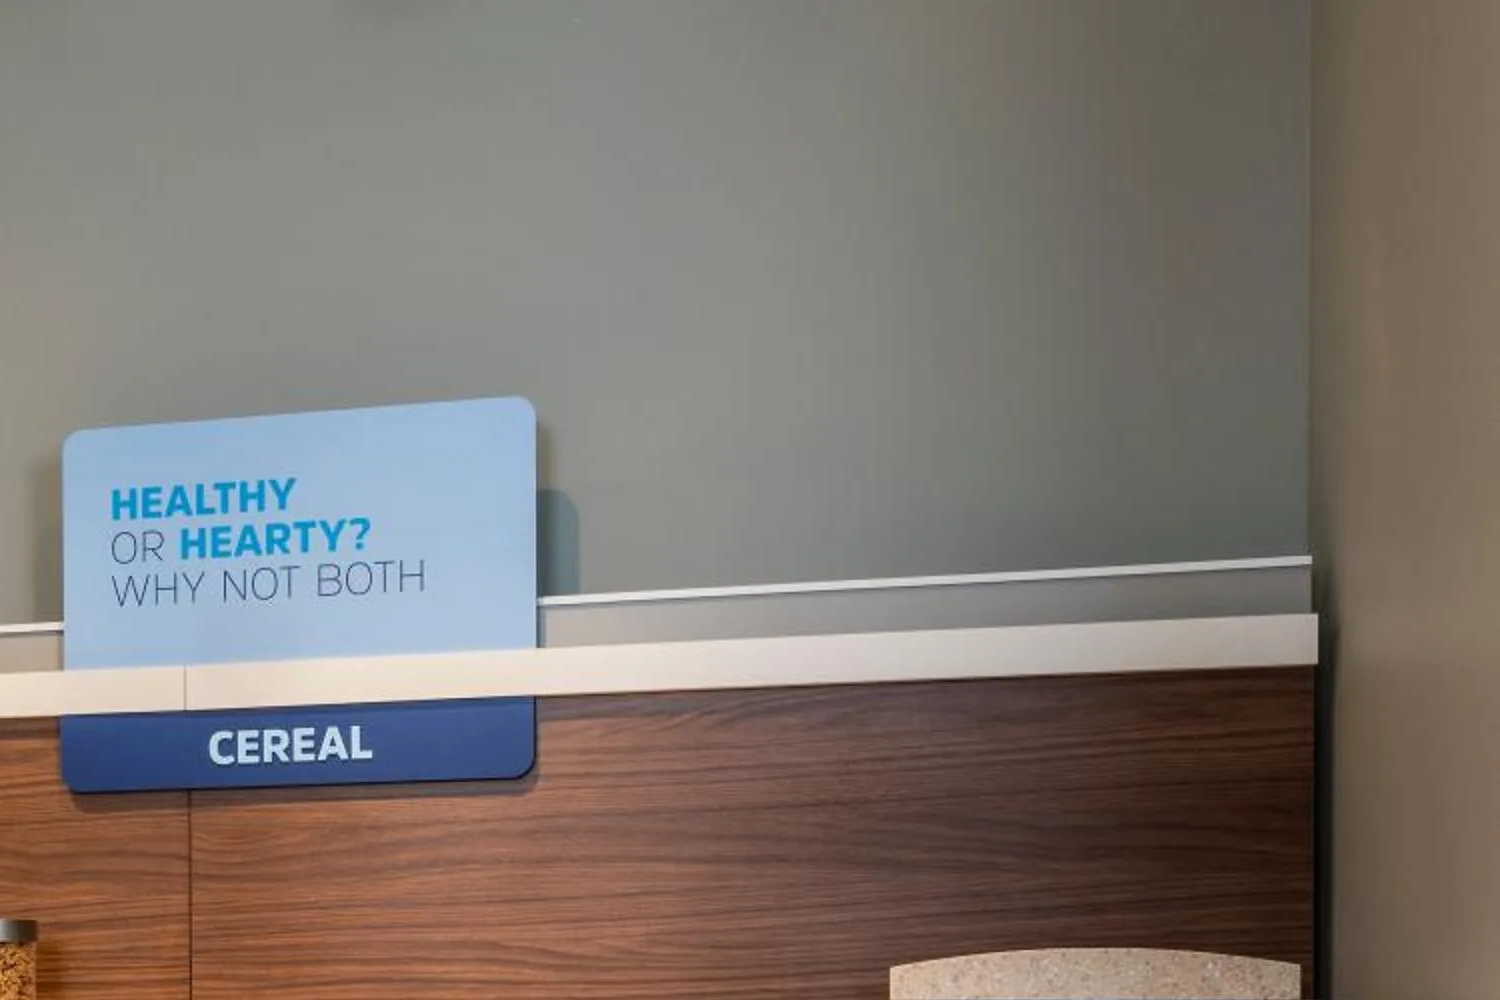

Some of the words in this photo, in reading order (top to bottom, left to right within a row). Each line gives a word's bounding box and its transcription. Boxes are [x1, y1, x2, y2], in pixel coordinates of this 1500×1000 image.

[110, 477, 297, 521] HEALTHY
[110, 530, 164, 564] OR
[180, 517, 372, 560] HEARTY?
[110, 571, 205, 607] WHY
[223, 564, 301, 603] NOT
[316, 558, 425, 598] BOTH
[208, 725, 373, 766] CEREAL
